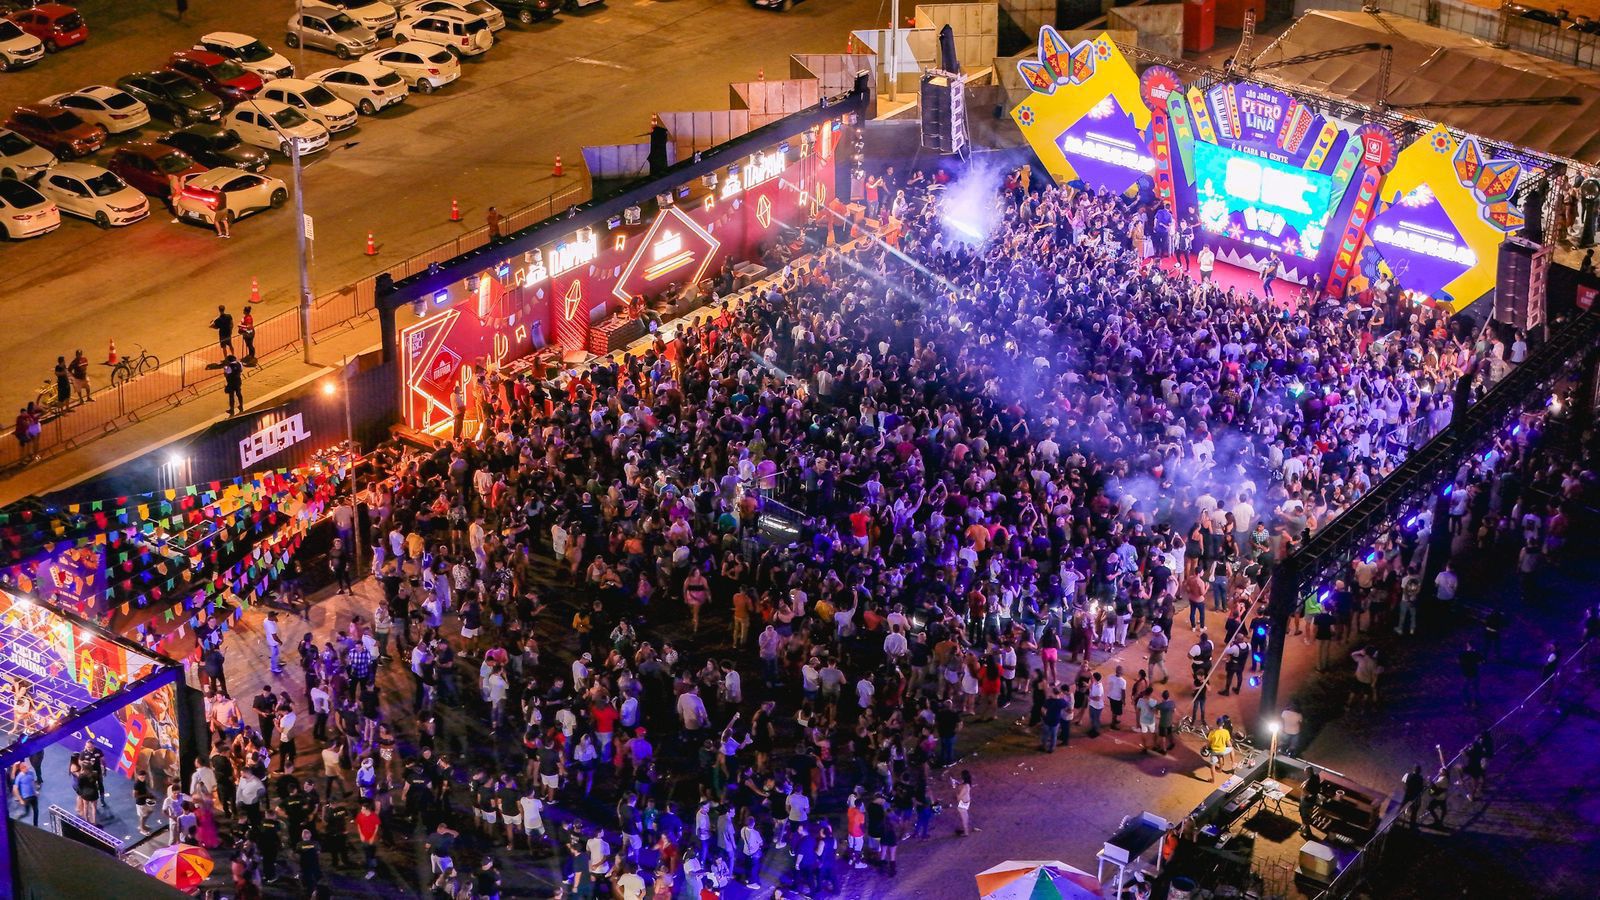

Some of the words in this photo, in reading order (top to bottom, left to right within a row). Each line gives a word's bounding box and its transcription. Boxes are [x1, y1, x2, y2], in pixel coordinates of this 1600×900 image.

[1246, 90, 1256, 99] SÃO
[1257, 92, 1270, 102] JOÃO
[1272, 96, 1278, 104] DE
[1241, 97, 1282, 120] PETRO
[1246, 113, 1275, 133] LINA
[1243, 146, 1258, 156] CARA
[1260, 150, 1268, 158] DA
[1270, 152, 1288, 164] GENTE
